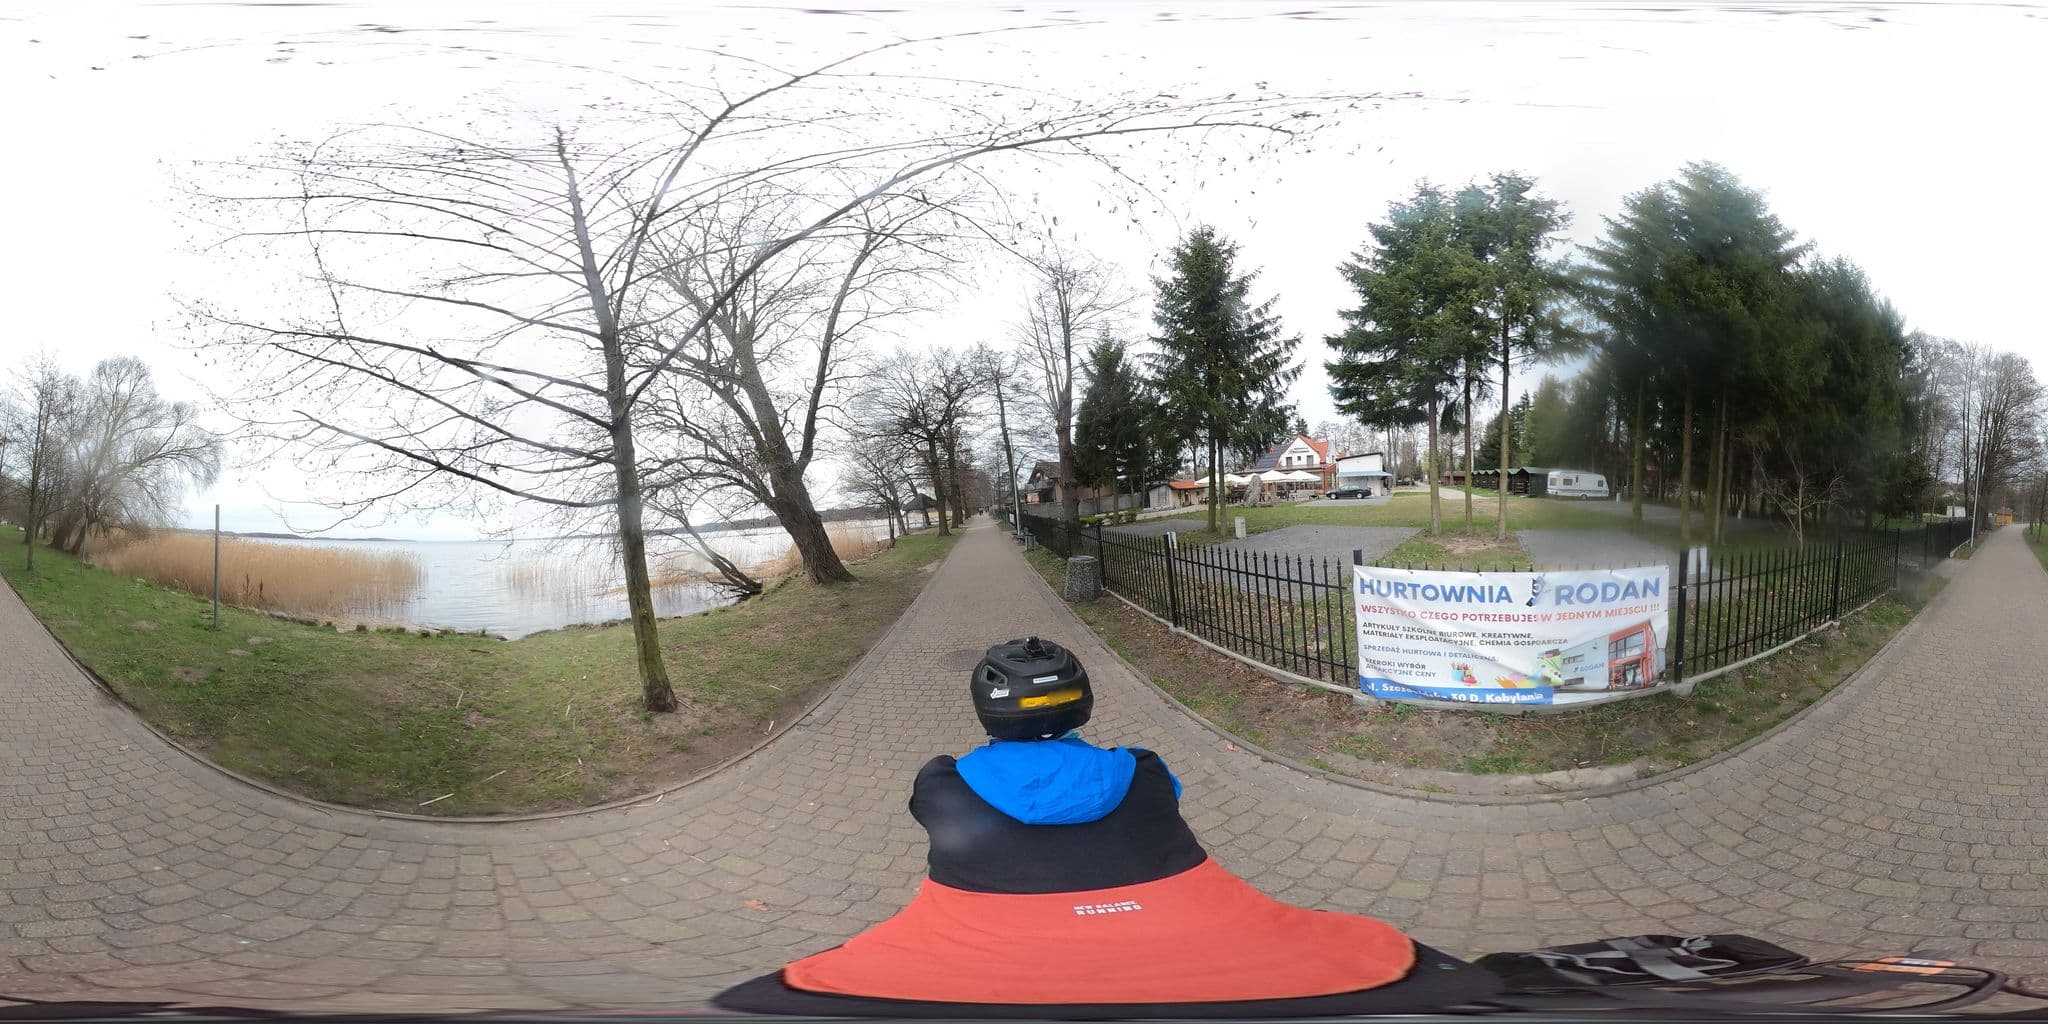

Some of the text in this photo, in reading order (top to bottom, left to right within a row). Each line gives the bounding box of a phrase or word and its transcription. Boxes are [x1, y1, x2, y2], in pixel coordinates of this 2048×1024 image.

[1360, 578, 1513, 603] HURTOWNIA
[1555, 577, 1660, 605] RODAN
[1361, 604, 1416, 618] WSZYSTKO
[1420, 611, 1458, 620] CZEGO
[1540, 613, 1552, 622] W
[1556, 611, 1602, 621] JEDNYM
[1605, 606, 1648, 618] MIEJSCU
[1514, 638, 1568, 646] GOSPODARCZA
[1402, 648, 1442, 656] HURTOWA
[1450, 693, 1466, 702] 30
[1075, 904, 1142, 916] RUNNING
